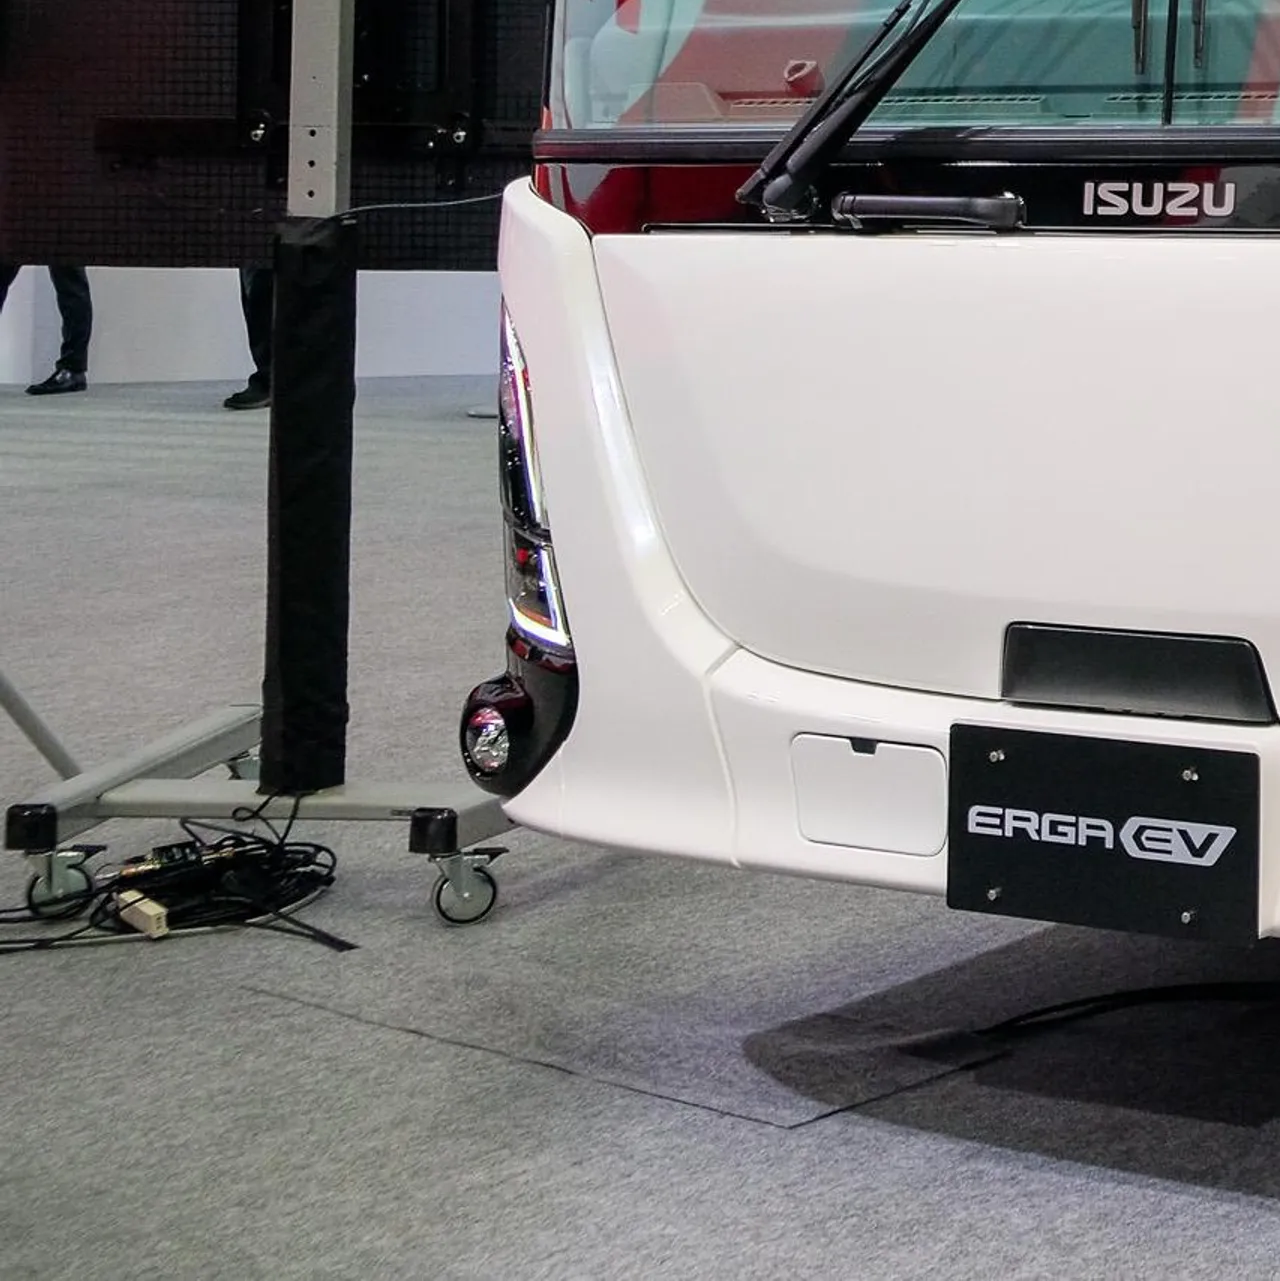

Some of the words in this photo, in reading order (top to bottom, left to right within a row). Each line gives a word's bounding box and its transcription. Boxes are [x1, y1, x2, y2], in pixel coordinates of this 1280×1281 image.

[1083, 182, 1235, 216] ISUZU
[967, 805, 1115, 849] ERGA
[1131, 824, 1220, 859] EV
